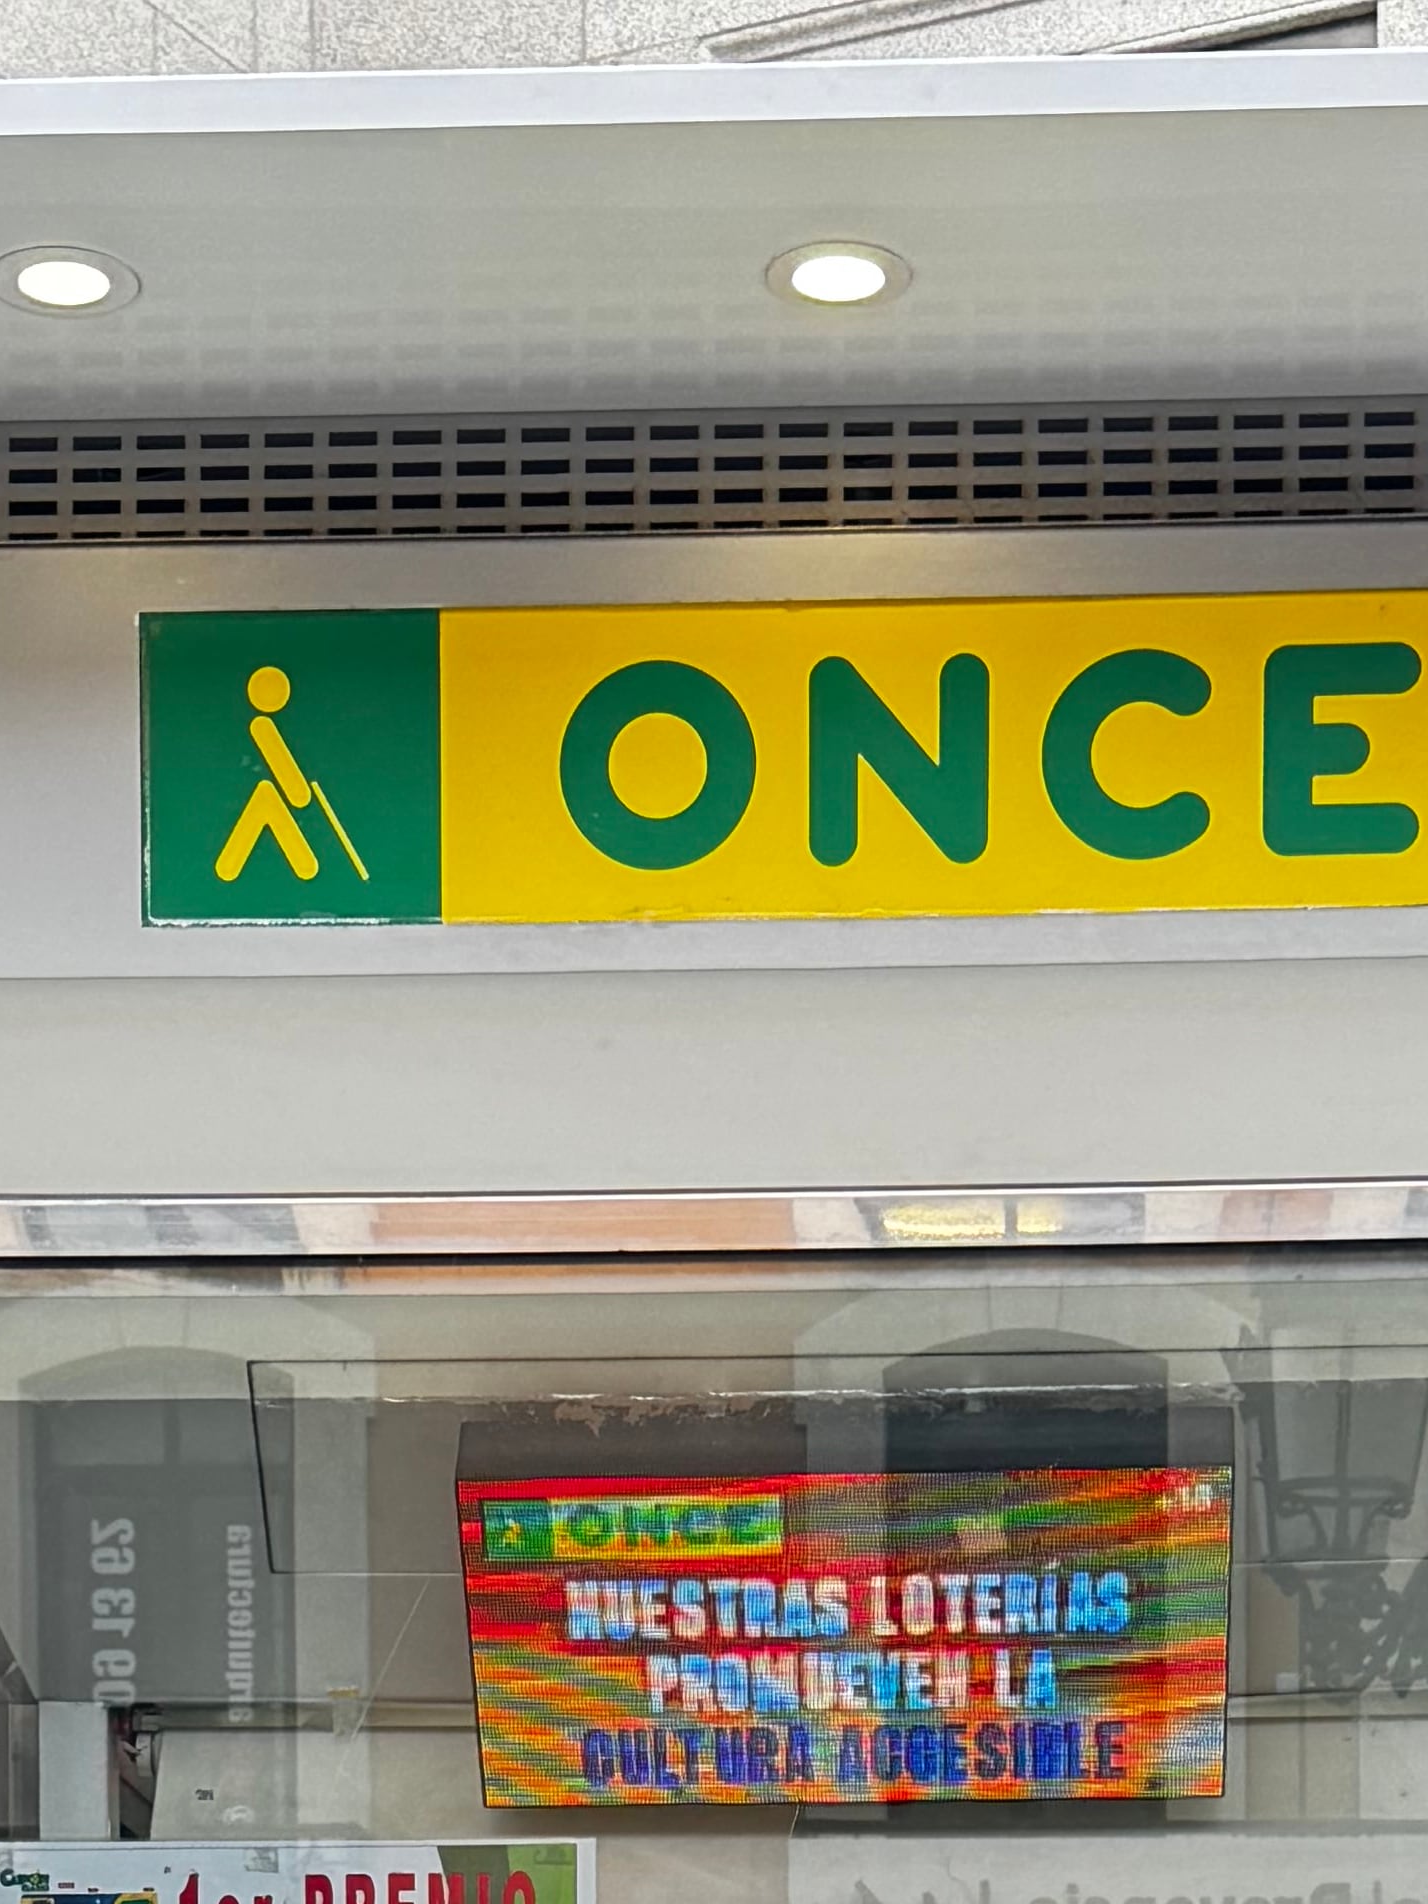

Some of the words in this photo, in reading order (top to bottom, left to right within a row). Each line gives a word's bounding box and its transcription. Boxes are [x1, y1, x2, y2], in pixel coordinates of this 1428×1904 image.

[560, 641, 1423, 871] ONCE
[565, 1500, 779, 1548] ONCE
[566, 1577, 849, 1641] NUESTRAS
[648, 1649, 972, 1715] PROMUEVEN
[993, 1650, 1058, 1710] LA
[582, 1723, 814, 1788] CULTURA
[836, 1719, 1128, 1783] ACCESIBLE
